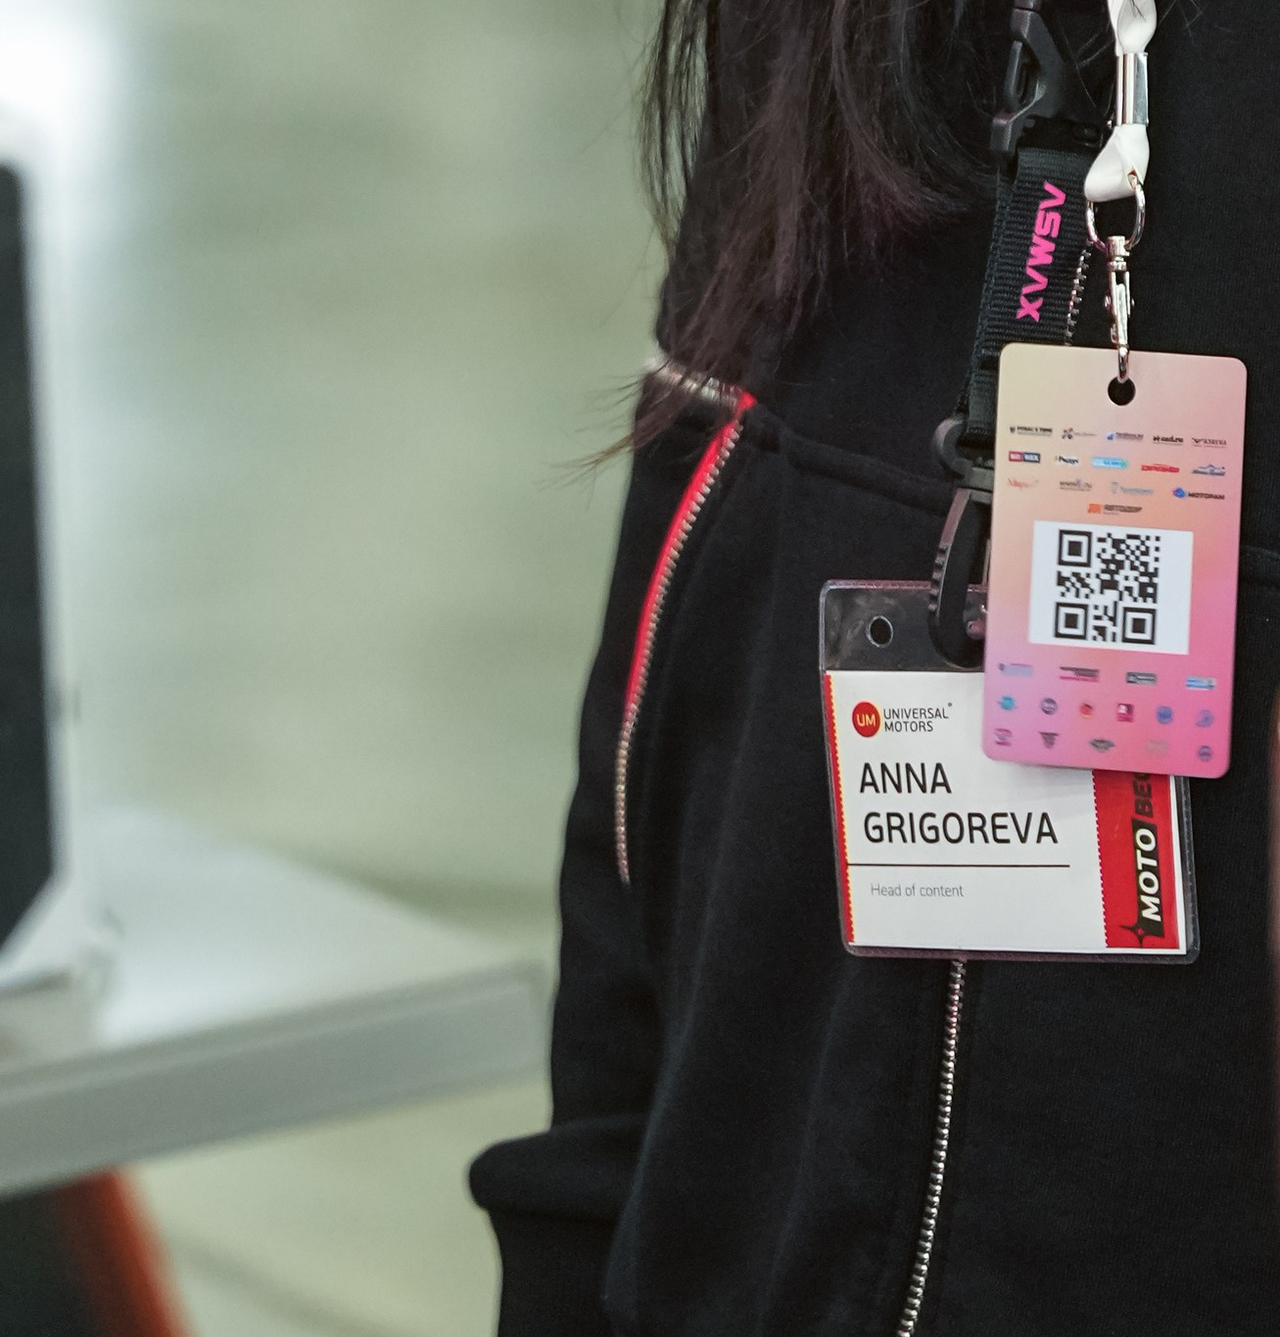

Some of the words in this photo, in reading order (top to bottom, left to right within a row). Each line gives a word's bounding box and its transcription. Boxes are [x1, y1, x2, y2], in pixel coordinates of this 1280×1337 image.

[856, 713, 876, 727] UM
[883, 707, 949, 720] UNIVERSAL
[884, 720, 934, 732] MOTORS
[859, 762, 952, 795] ANNA
[863, 811, 1059, 845] GRIGOREVA
[870, 882, 902, 897] Head
[905, 883, 917, 897] of
[919, 885, 965, 897] content
